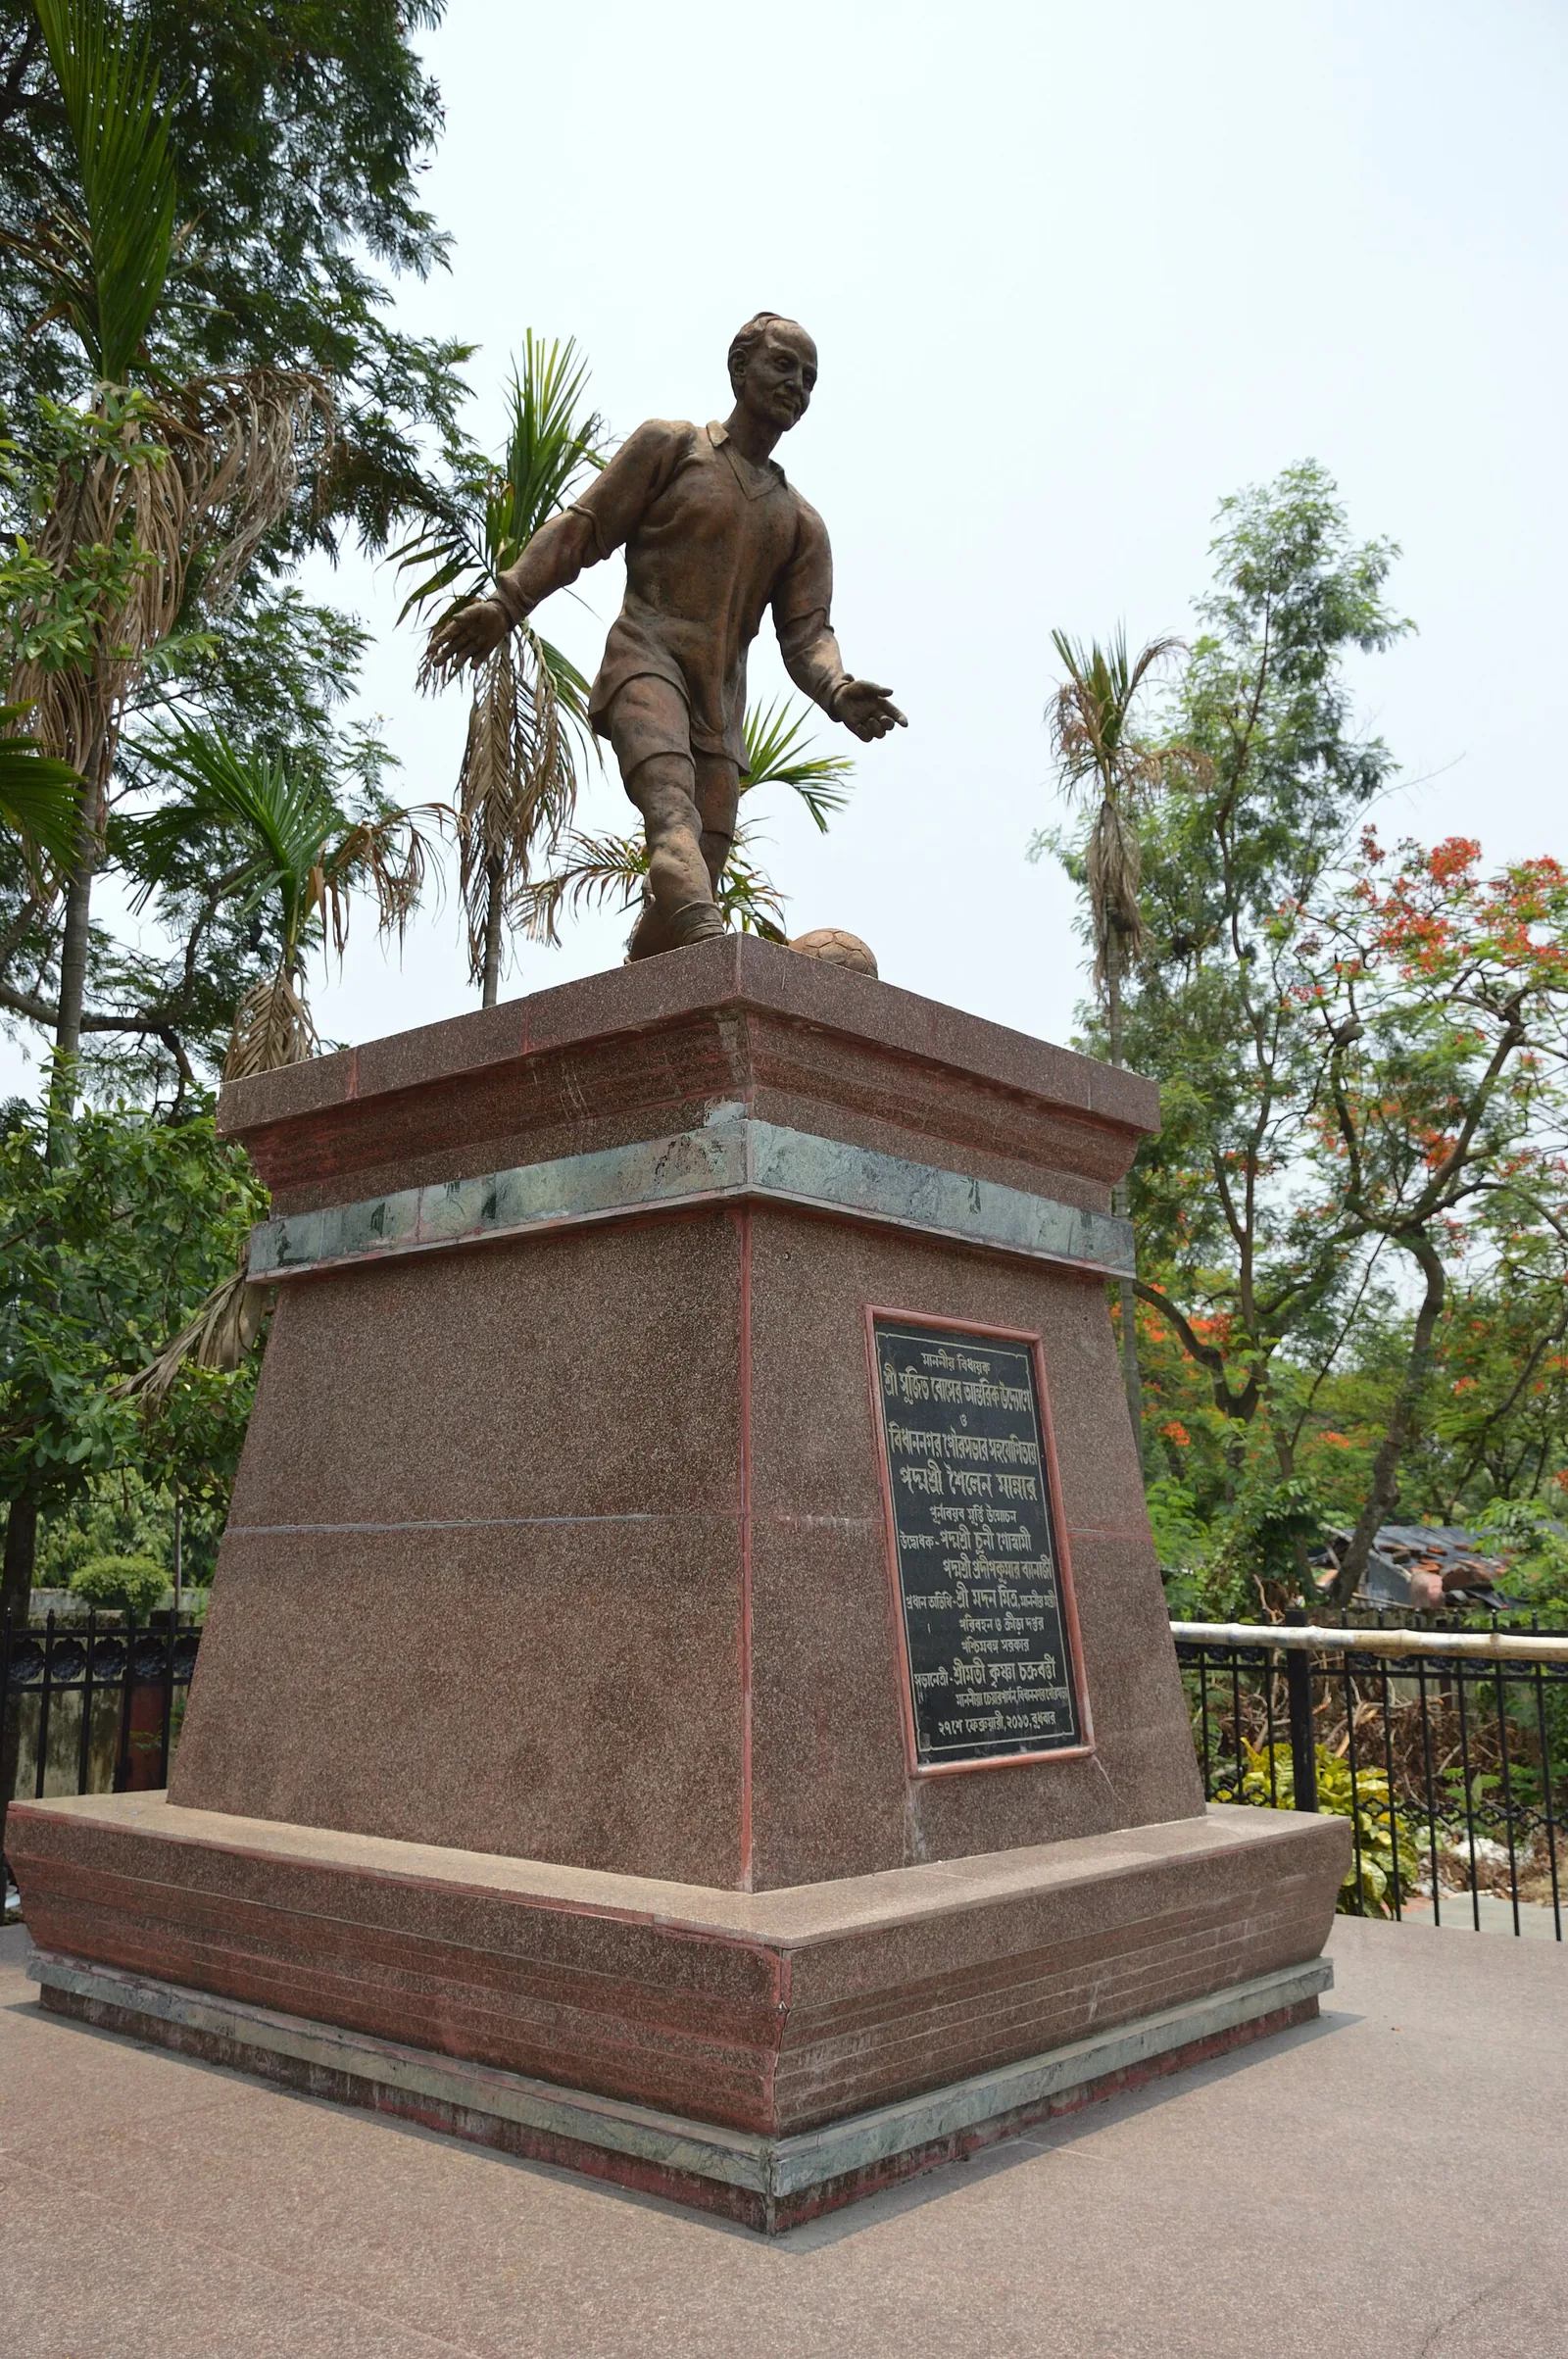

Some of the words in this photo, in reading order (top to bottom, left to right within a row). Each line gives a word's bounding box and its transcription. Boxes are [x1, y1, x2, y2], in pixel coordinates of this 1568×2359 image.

[884, 1363, 899, 1397] শ্রী
[899, 1366, 930, 1405] সুজিত
[930, 1376, 963, 1404] বোসের
[959, 1413, 968, 1427] ও
[888, 1420, 942, 1457] বিধাননগর
[900, 1458, 944, 1496] পদ্মশ্রী
[944, 1461, 993, 1499] শৈলেন
[996, 1473, 1038, 1501] মান্নার
[939, 1524, 971, 1550] পদ্মশ্রী
[942, 1552, 972, 1579] পদ্মশ্রী
[956, 1581, 969, 1609] শ্রী
[971, 1589, 997, 1608] মদন
[958, 1612, 994, 1633] পরিবহন
[1001, 1638, 1030, 1652] সরকার
[953, 1656, 987, 1687] শ্রীমতী
